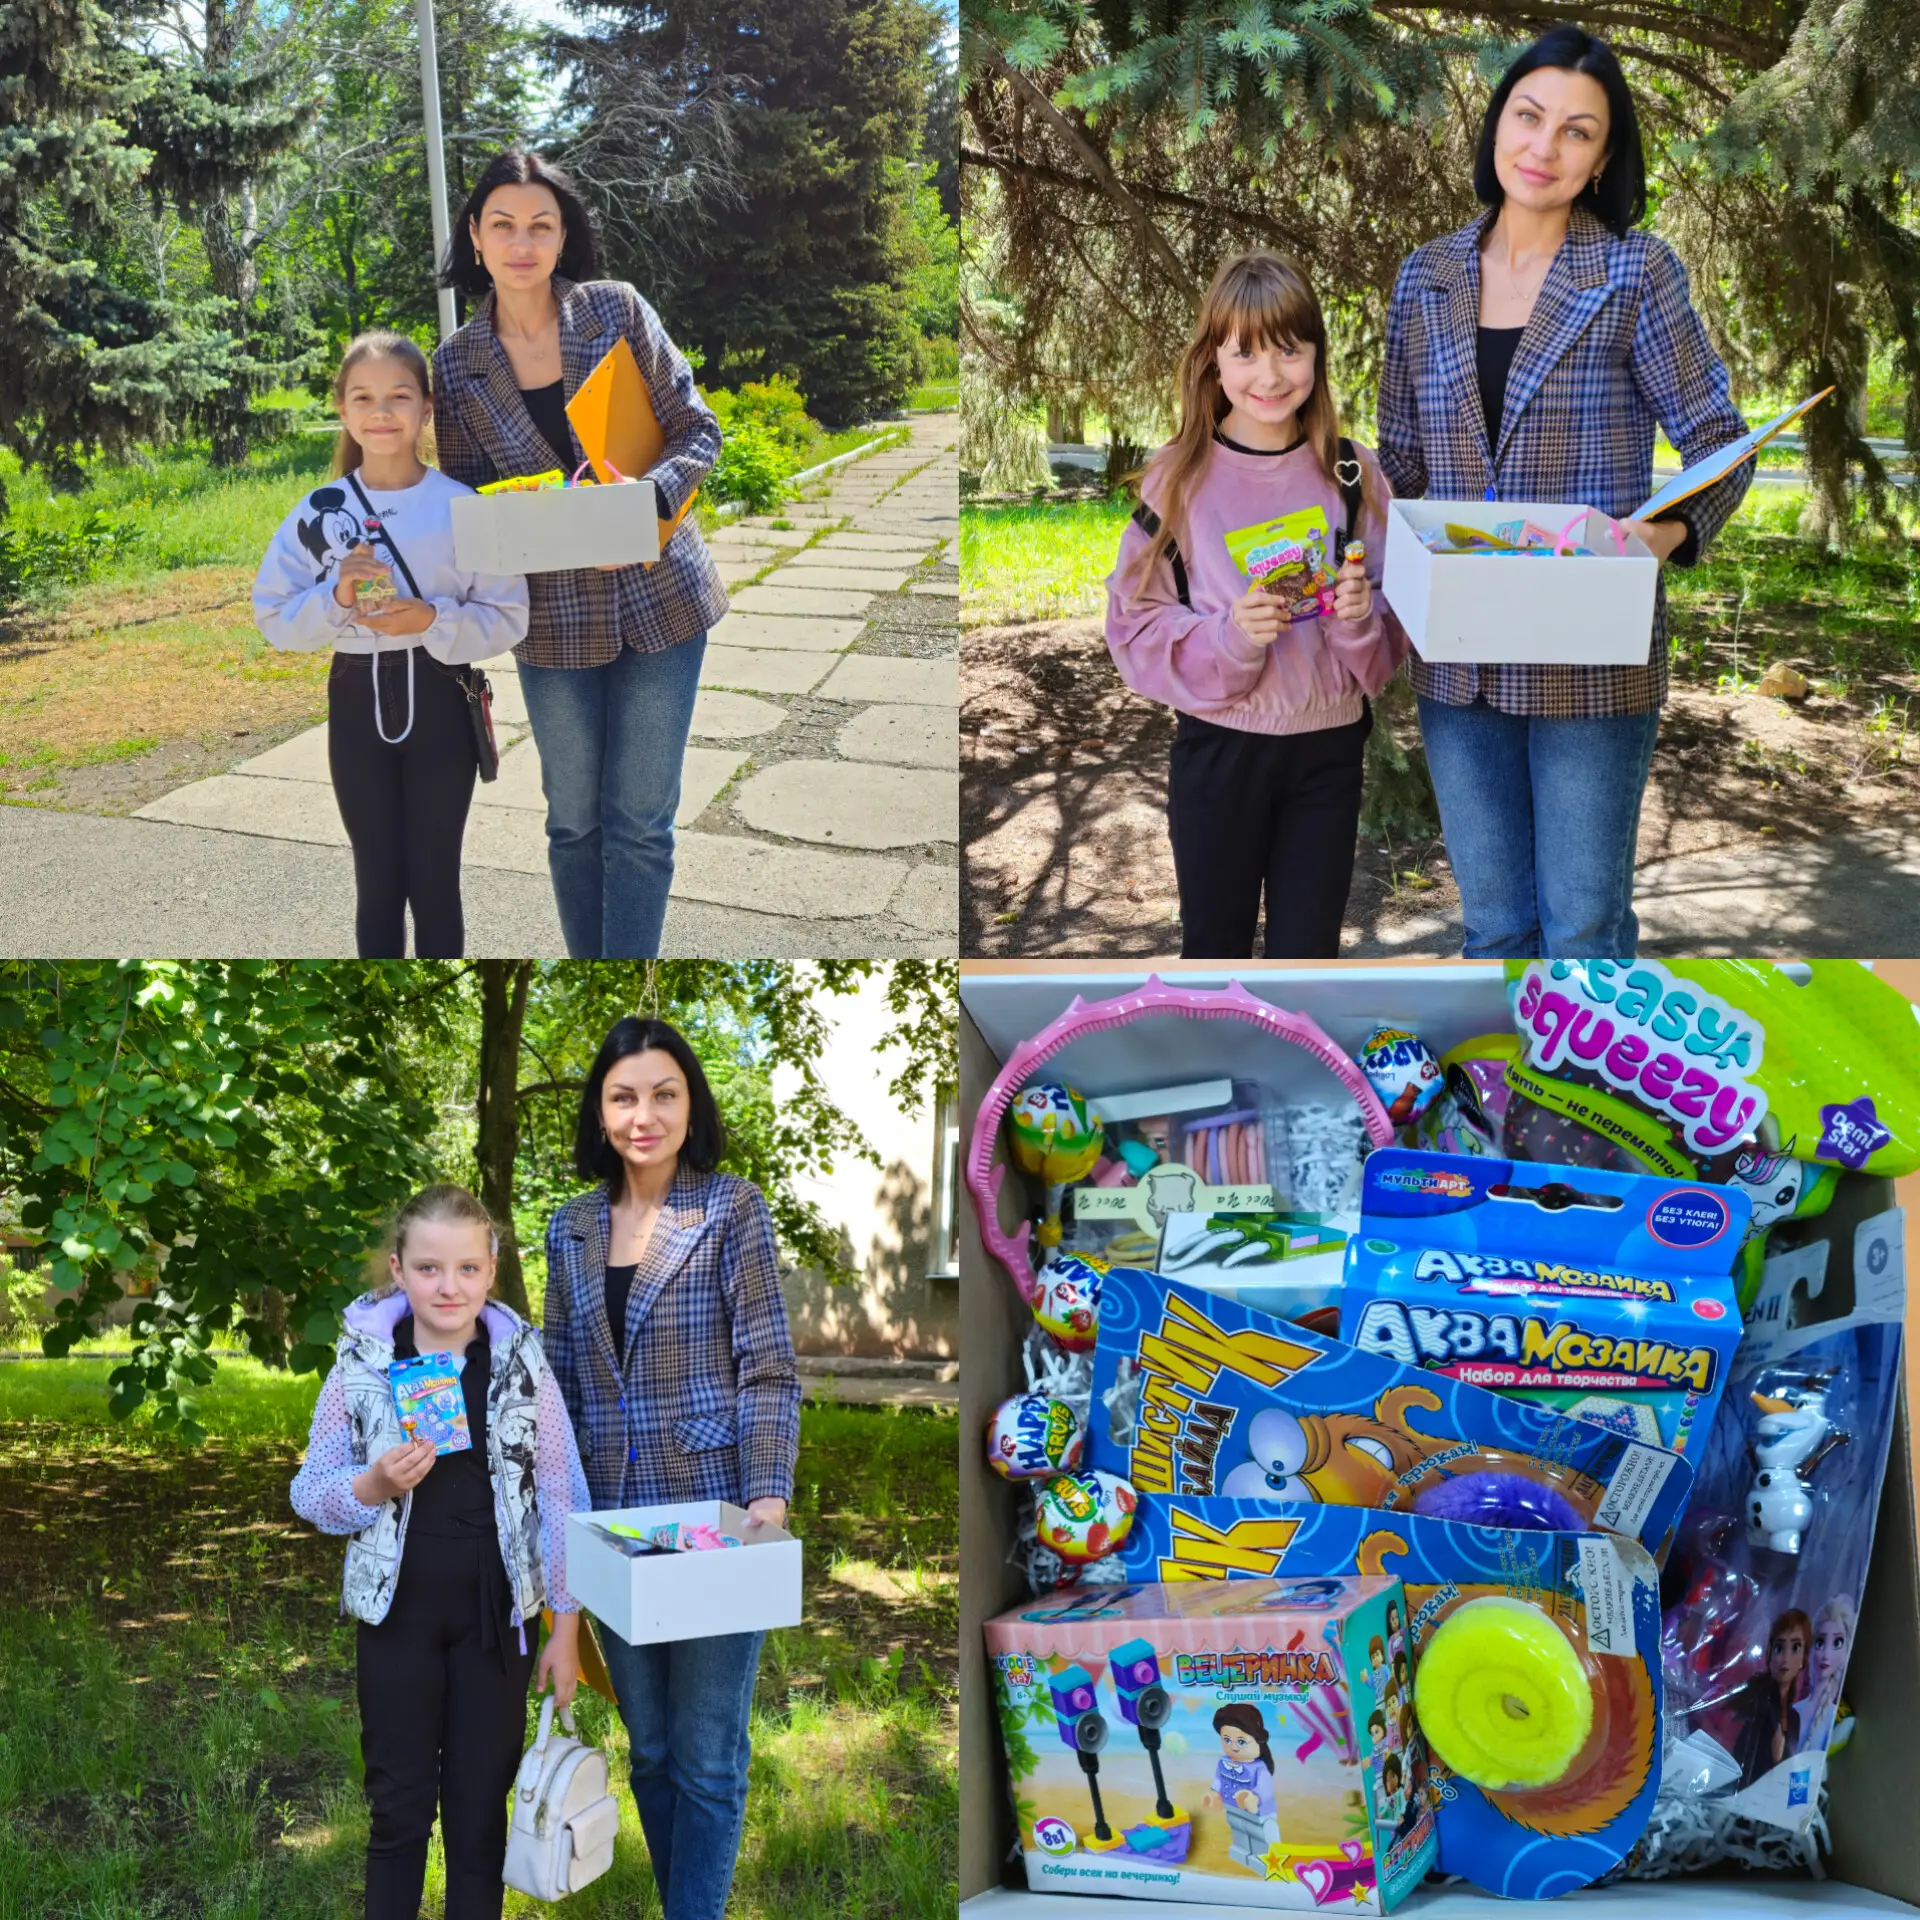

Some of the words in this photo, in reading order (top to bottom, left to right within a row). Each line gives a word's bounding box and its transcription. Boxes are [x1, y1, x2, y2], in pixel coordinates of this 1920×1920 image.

[1519, 974, 1757, 1148] squeezy
[1662, 1206, 1683, 1215] БЕЗ
[1654, 1215, 1675, 1223] БЕЗ
[1679, 1218, 1720, 1229] УТЮГА!
[1460, 1367, 1515, 1385] Набор
[1519, 1373, 1551, 1387] для
[1556, 1374, 1637, 1387] творчества
[1409, 1580, 1461, 1643] рюкам!
[1216, 1690, 1261, 1702] Слушай
[1263, 1691, 1310, 1704] музыку!
[1042, 1864, 1077, 1878] Собери
[1079, 1869, 1103, 1878] всех
[1105, 1870, 1119, 1879] на
[1121, 1871, 1181, 1886] вечеринку!
